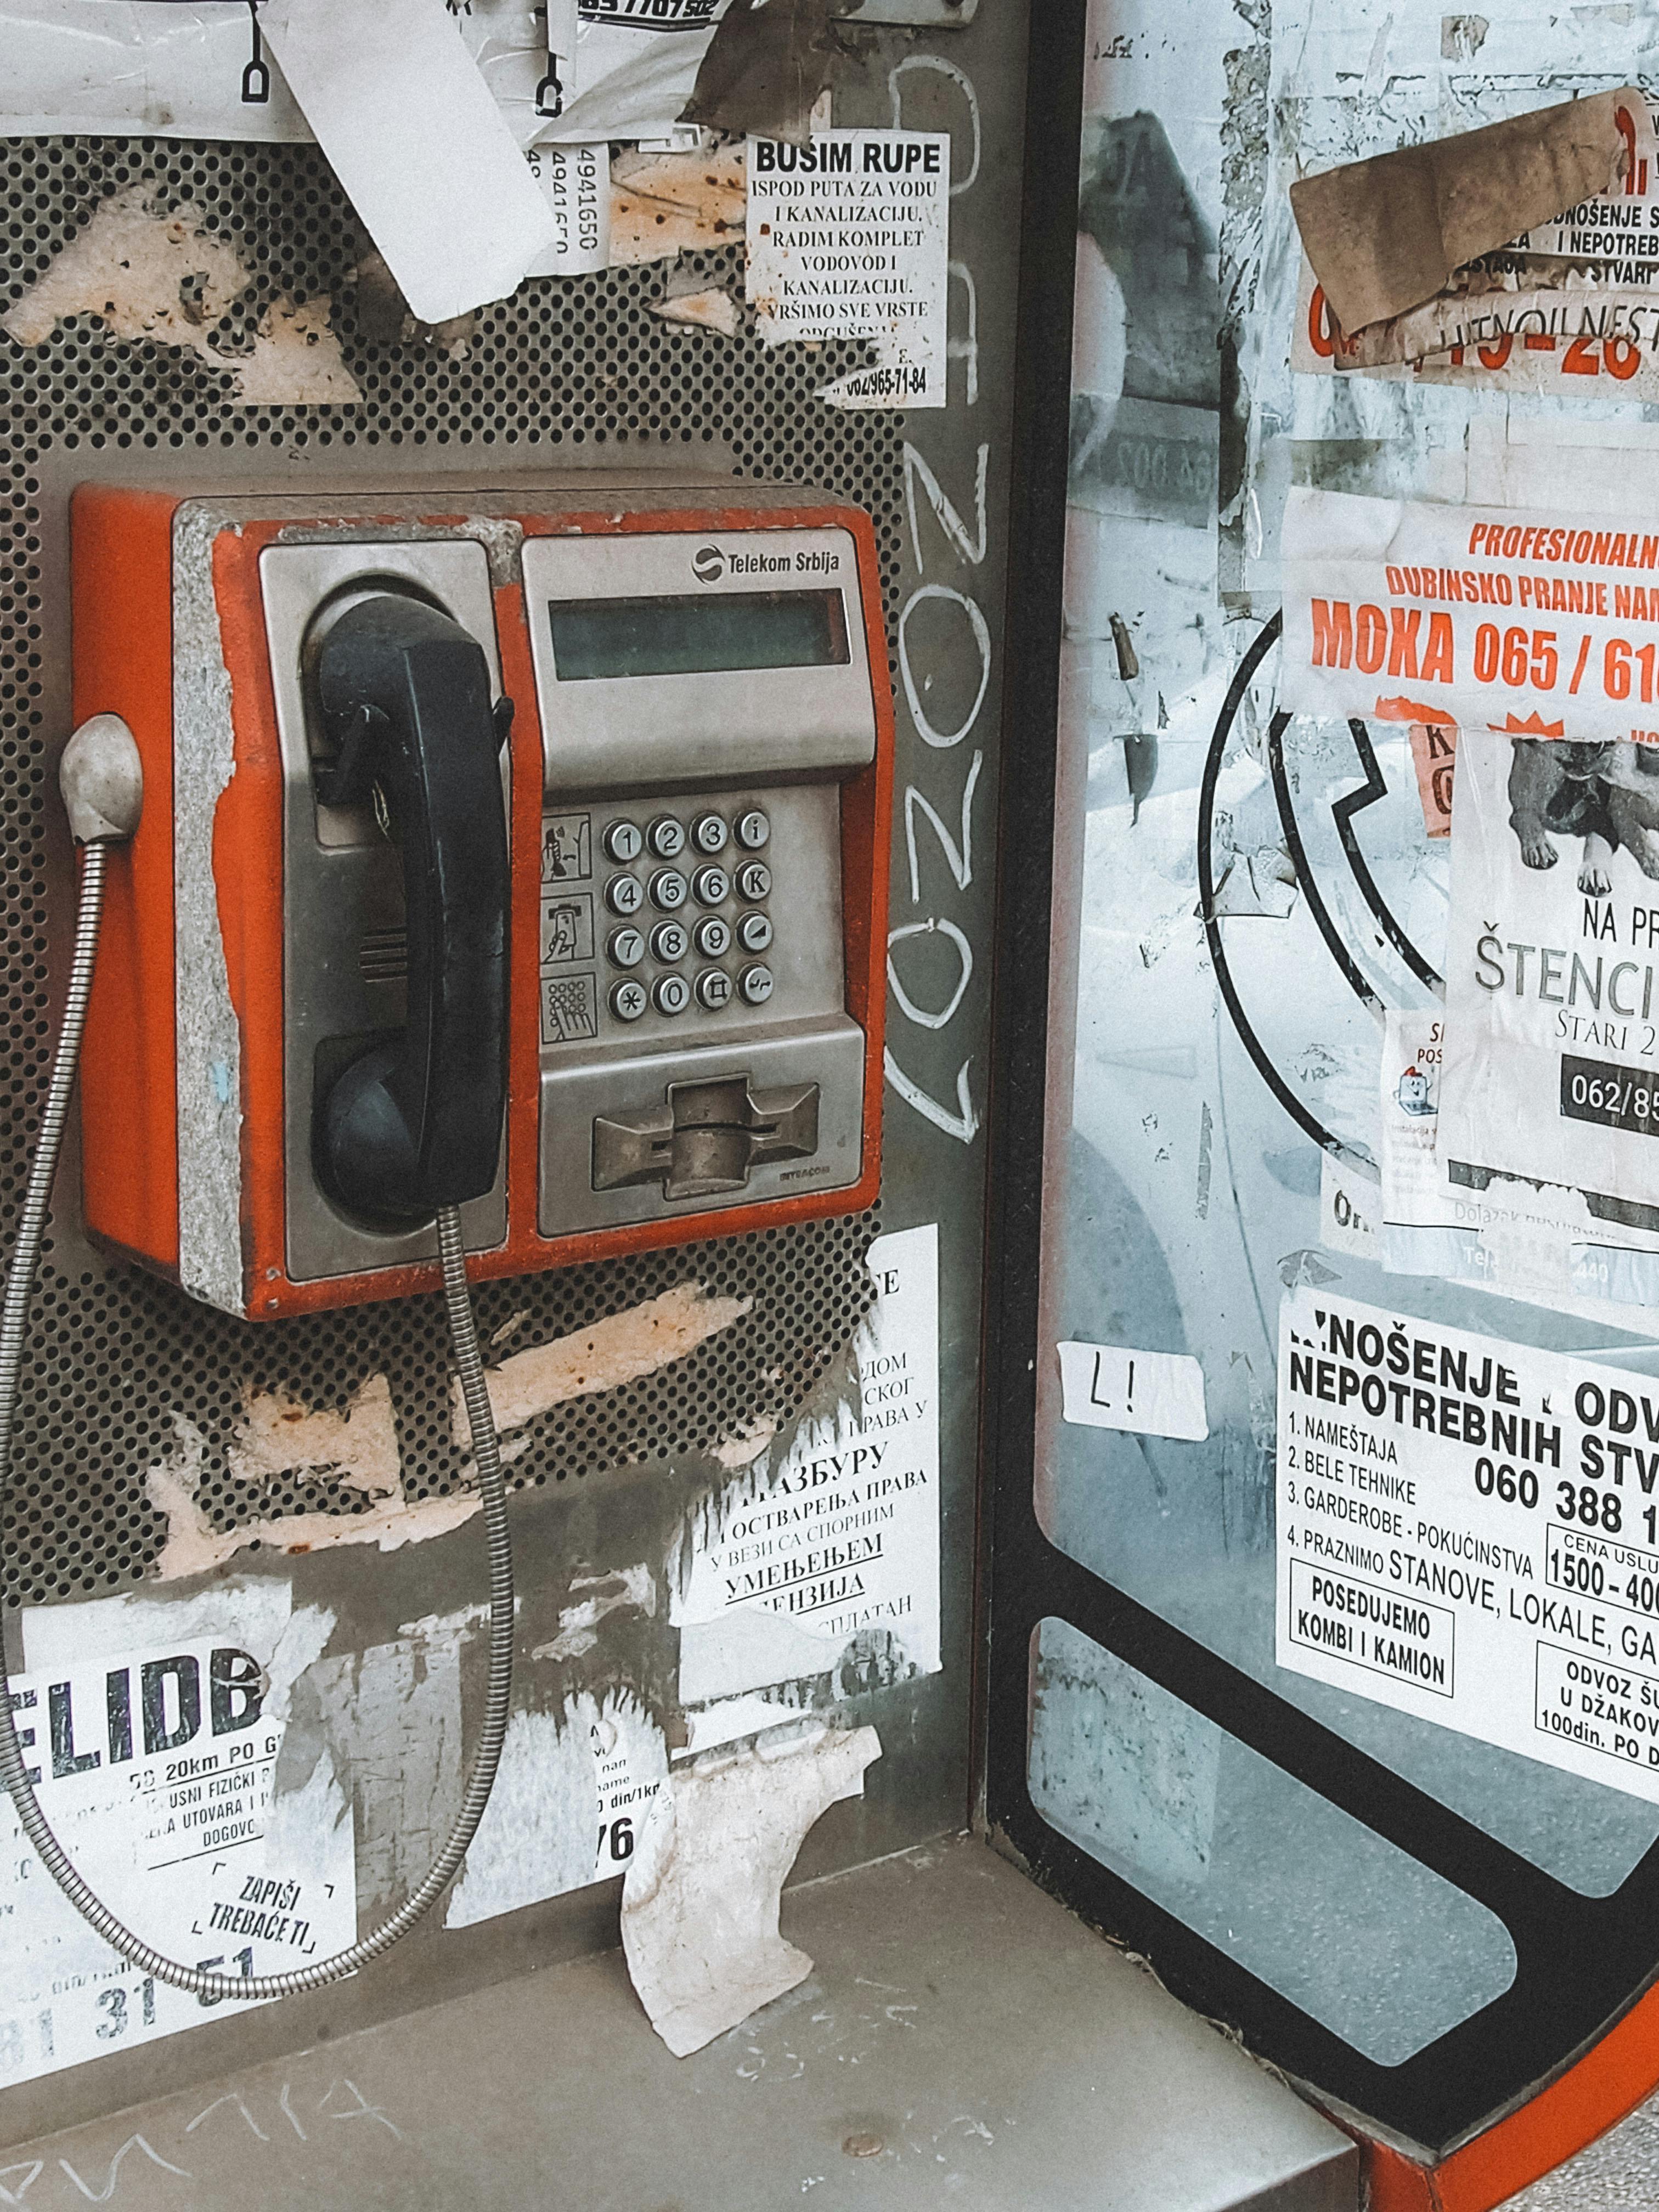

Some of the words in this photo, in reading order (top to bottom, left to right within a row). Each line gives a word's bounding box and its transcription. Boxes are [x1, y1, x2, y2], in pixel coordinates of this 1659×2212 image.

[863, 143, 940, 173] RUPE
[752, 180, 805, 197] ISPOD
[810, 180, 855, 197] PUTA
[860, 181, 883, 197] ZA
[888, 181, 937, 197] VODU
[775, 206, 781, 222] I
[787, 206, 922, 222] KANALIZACIJU.
[1545, 198, 1642, 228] DNOŠENJE
[773, 231, 833, 247] RADIM
[838, 230, 924, 246] KOMPLET
[801, 255, 886, 271] VODOVOD
[891, 255, 896, 270] I
[783, 279, 913, 295] KANALIZACIJU.
[768, 300, 835, 320] VRŠIMO
[839, 303, 871, 318] SVE
[875, 301, 928, 318] VRSTE
[728, 554, 791, 573] Telekom
[795, 551, 839, 575] Srbija
[1385, 566, 1511, 606] DUBINSKO
[1518, 575, 1608, 616] PRANJE
[1311, 597, 1454, 684] MOXA
[1473, 623, 1558, 690] 065
[1603, 638, 1659, 703] 61
[623, 831, 632, 854] 1
[663, 826, 678, 850] 2
[705, 823, 721, 846] 3
[752, 819, 759, 840] i
[622, 884, 637, 907] 4
[664, 879, 680, 902] 5
[707, 875, 723, 898] 6
[749, 870, 766, 893] K
[1583, 898, 1617, 943] NA
[623, 936, 639, 959] 7
[665, 932, 681, 955] 8
[708, 926, 724, 950] 9
[1475, 920, 1652, 1019] ŠTENCI
[1555, 1009, 1627, 1051] STARI
[1640, 1026, 1656, 1055] 2
[861, 1352, 906, 1382] ДОМ
[1091, 1351, 1135, 1413] L!
[915, 1400, 928, 1419] У
[1290, 1351, 1561, 1468] NEPOTREBNIH
[1305, 1415, 1398, 1465] NAMEŠTAJA
[867, 1469, 927, 1502] ПРАВА
[1288, 1445, 1300, 1469] 2.
[1305, 1450, 1344, 1483] BELE
[1349, 1464, 1416, 1505] TEHNIKE
[1475, 1457, 1539, 1509] 060
[1556, 1481, 1622, 1533] 388
[729, 1539, 772, 1566] ВЕЗИ
[778, 1533, 802, 1550] СА
[807, 1503, 894, 1542] СПОРНИМ
[1288, 1481, 1300, 1505] 3.
[1304, 1486, 1402, 1538] GARDEROBE
[1418, 1521, 1533, 1580] POKUĆINSTVA
[1564, 1533, 1609, 1560] CENA
[725, 1533, 883, 1599] УМЕЊЕЊЕМ
[1288, 1525, 1299, 1548] 4.
[1304, 1530, 1384, 1575] PRAZNIMO
[1389, 1549, 1501, 1618] STANOVE,
[1509, 1588, 1612, 1656] LOKALE,
[1312, 1575, 1430, 1639] POSEDUJEMO
[1298, 1609, 1353, 1652] KOMBI
[1361, 1631, 1365, 1656] I
[1374, 1637, 1444, 1685] KAMION
[1560, 1686, 1572, 1707] U
[1567, 1661, 1632, 1700] ODVOZ
[1542, 1709, 1605, 1747] 100din.
[1615, 1733, 1639, 1758] PO
[166, 1754, 219, 1781] 20km
[229, 1742, 254, 1764] PO
[209, 1770, 255, 1798] FIZIČKI
[183, 1798, 242, 1829] UTOVARA
[239, 1875, 301, 1911] ZAPIŠI
[95, 1977, 156, 2039] 31
